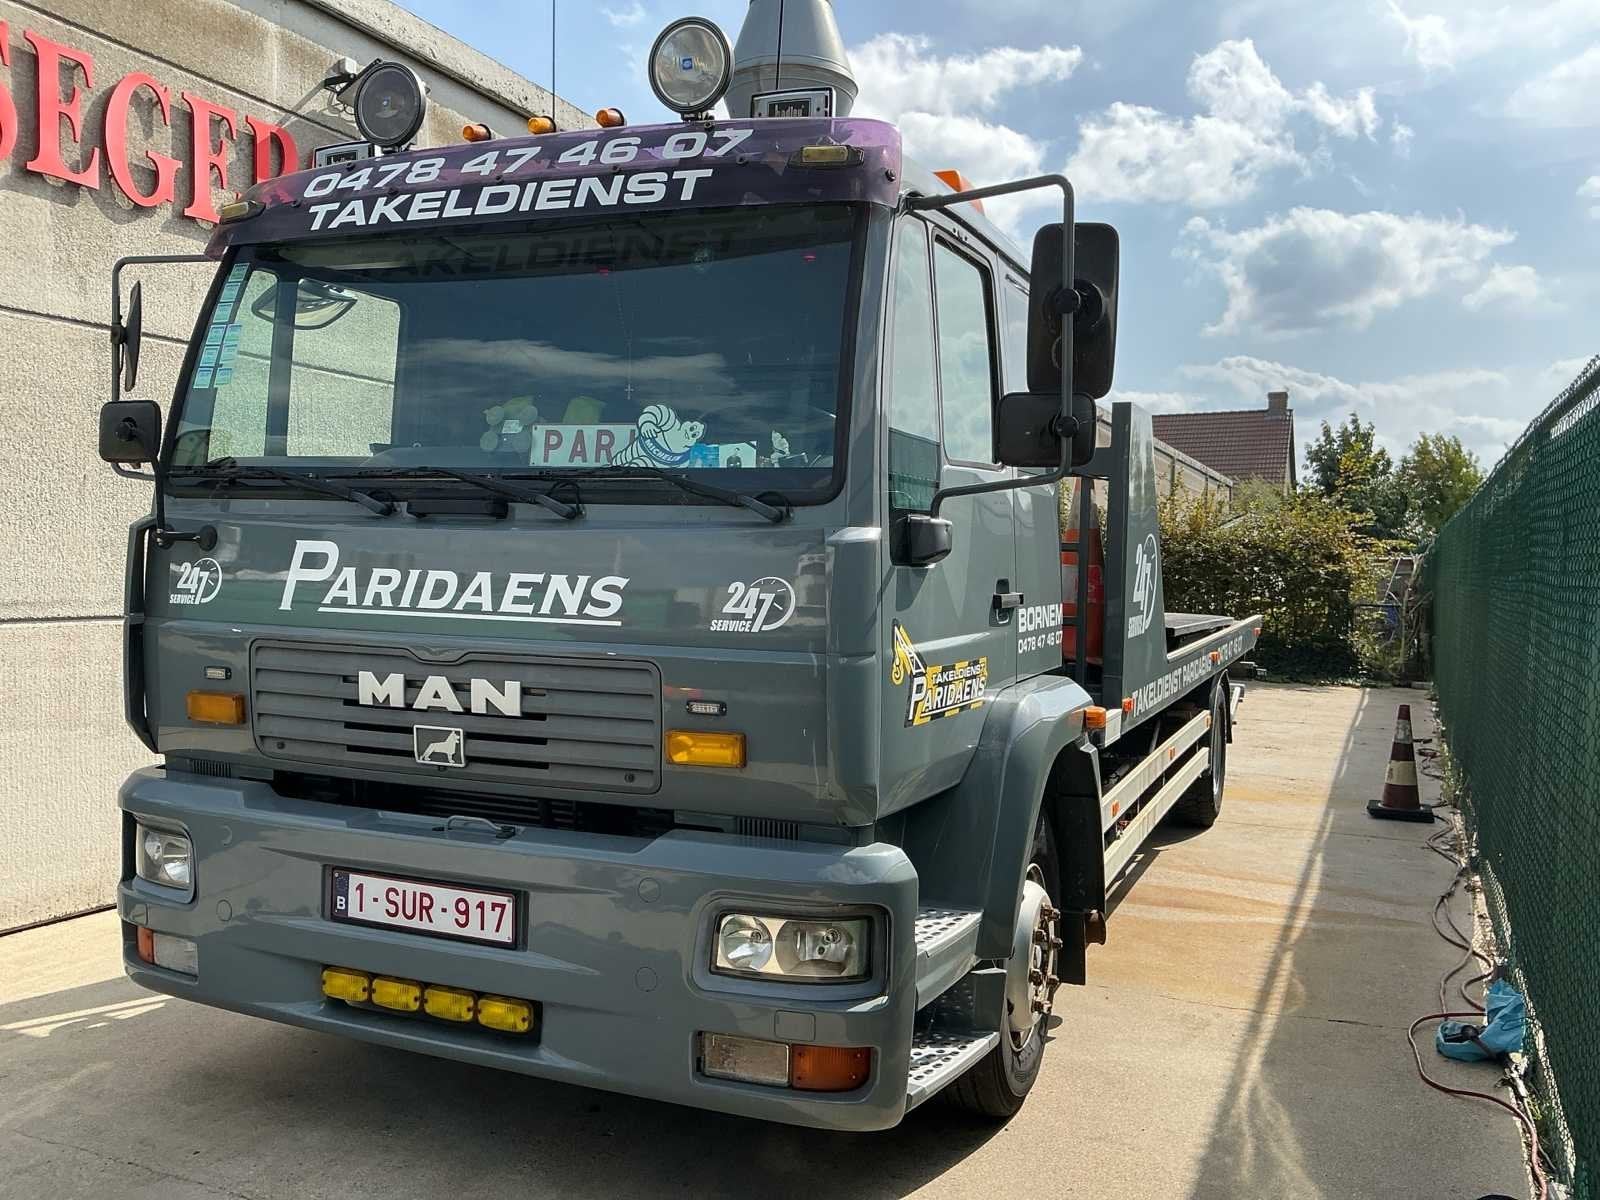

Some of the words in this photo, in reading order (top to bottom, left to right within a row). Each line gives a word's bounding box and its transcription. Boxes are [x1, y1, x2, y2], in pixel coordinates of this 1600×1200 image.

[303, 156, 446, 198] 0478
[460, 147, 541, 176] 47
[558, 136, 642, 166] 46
[662, 128, 754, 160] 07
[308, 168, 713, 231] TAKELDIENST
[278, 539, 630, 618] PARIDAENS
[709, 619, 753, 633] SERVICE
[1017, 635, 1036, 654] 0478
[358, 670, 522, 717] MAN
[931, 662, 986, 685] TAKELDIENST
[1131, 667, 1182, 718] TAKELDIENST
[907, 675, 987, 721] PARIDAENS
[336, 895, 346, 911] B
[355, 883, 507, 933] 1-SUR-917
